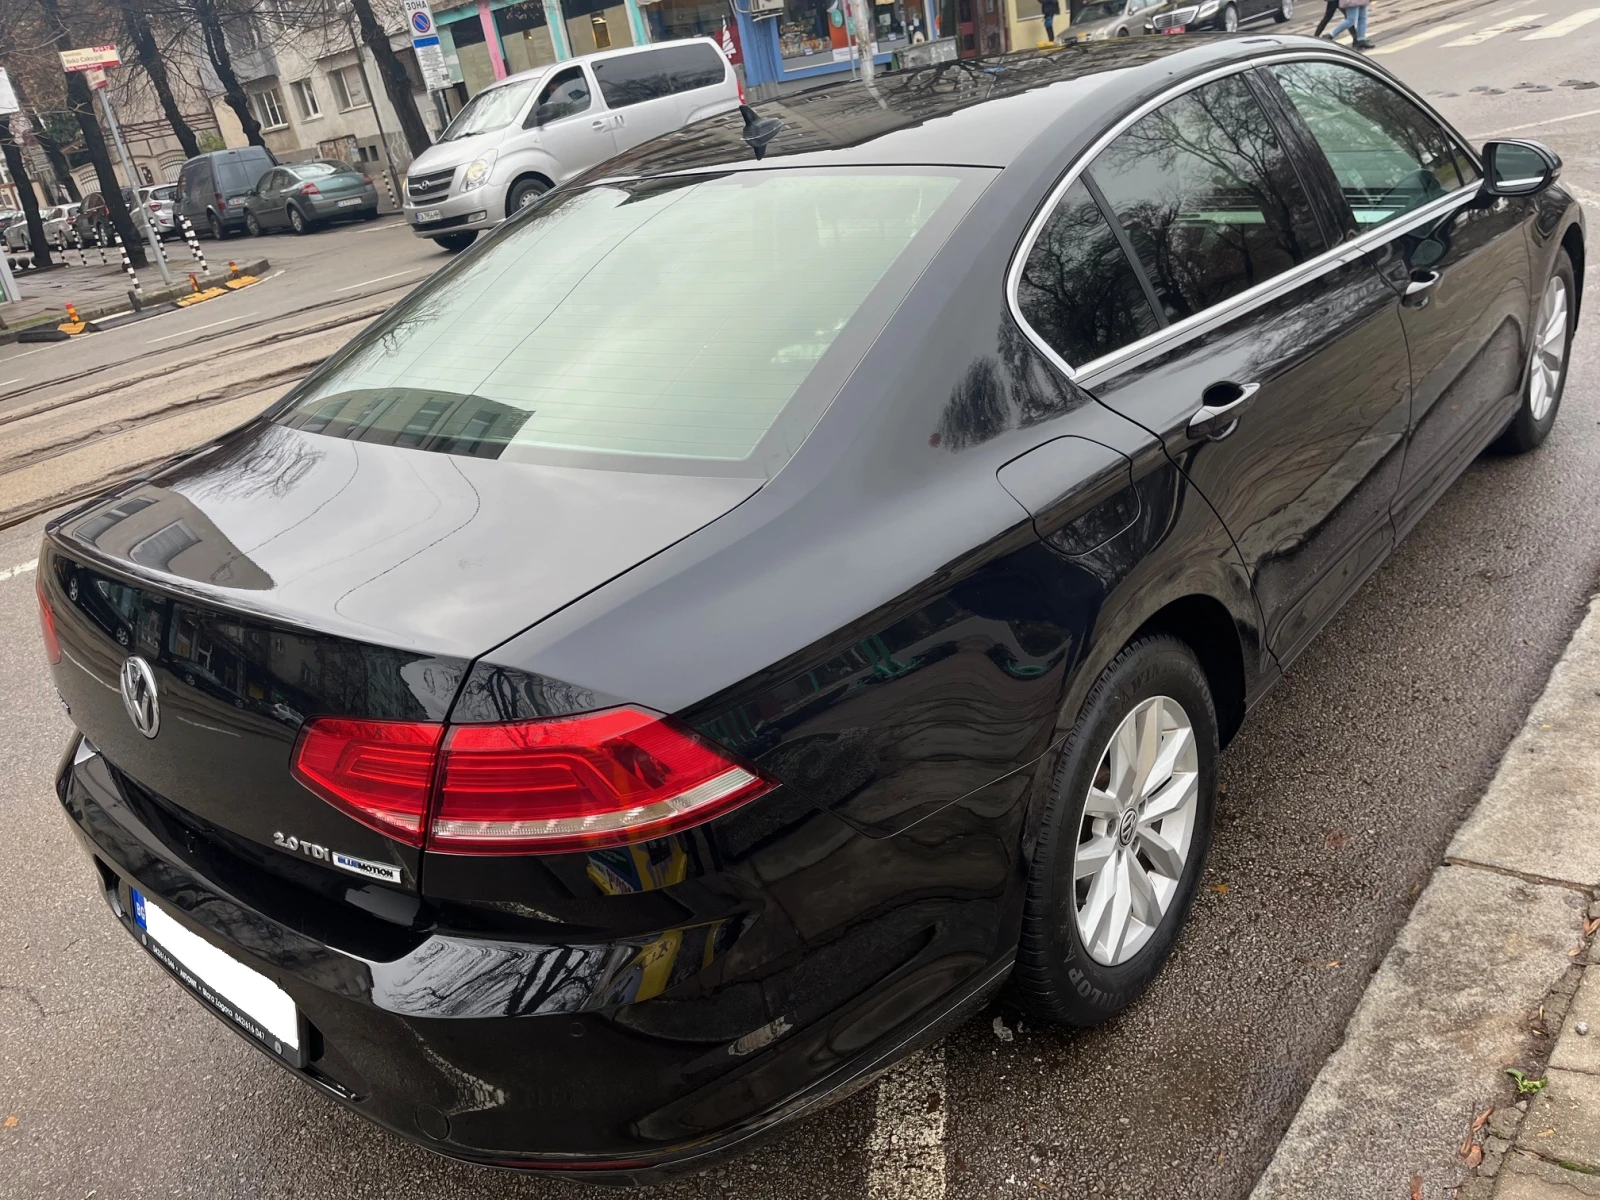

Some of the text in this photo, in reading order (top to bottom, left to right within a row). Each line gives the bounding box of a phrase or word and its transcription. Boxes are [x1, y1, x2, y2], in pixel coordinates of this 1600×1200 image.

[405, 0, 428, 11] ЗОНА
[273, 830, 331, 862] 2.0 TDI
[337, 855, 394, 878] BLUEMOTION
[135, 901, 146, 921] BG
